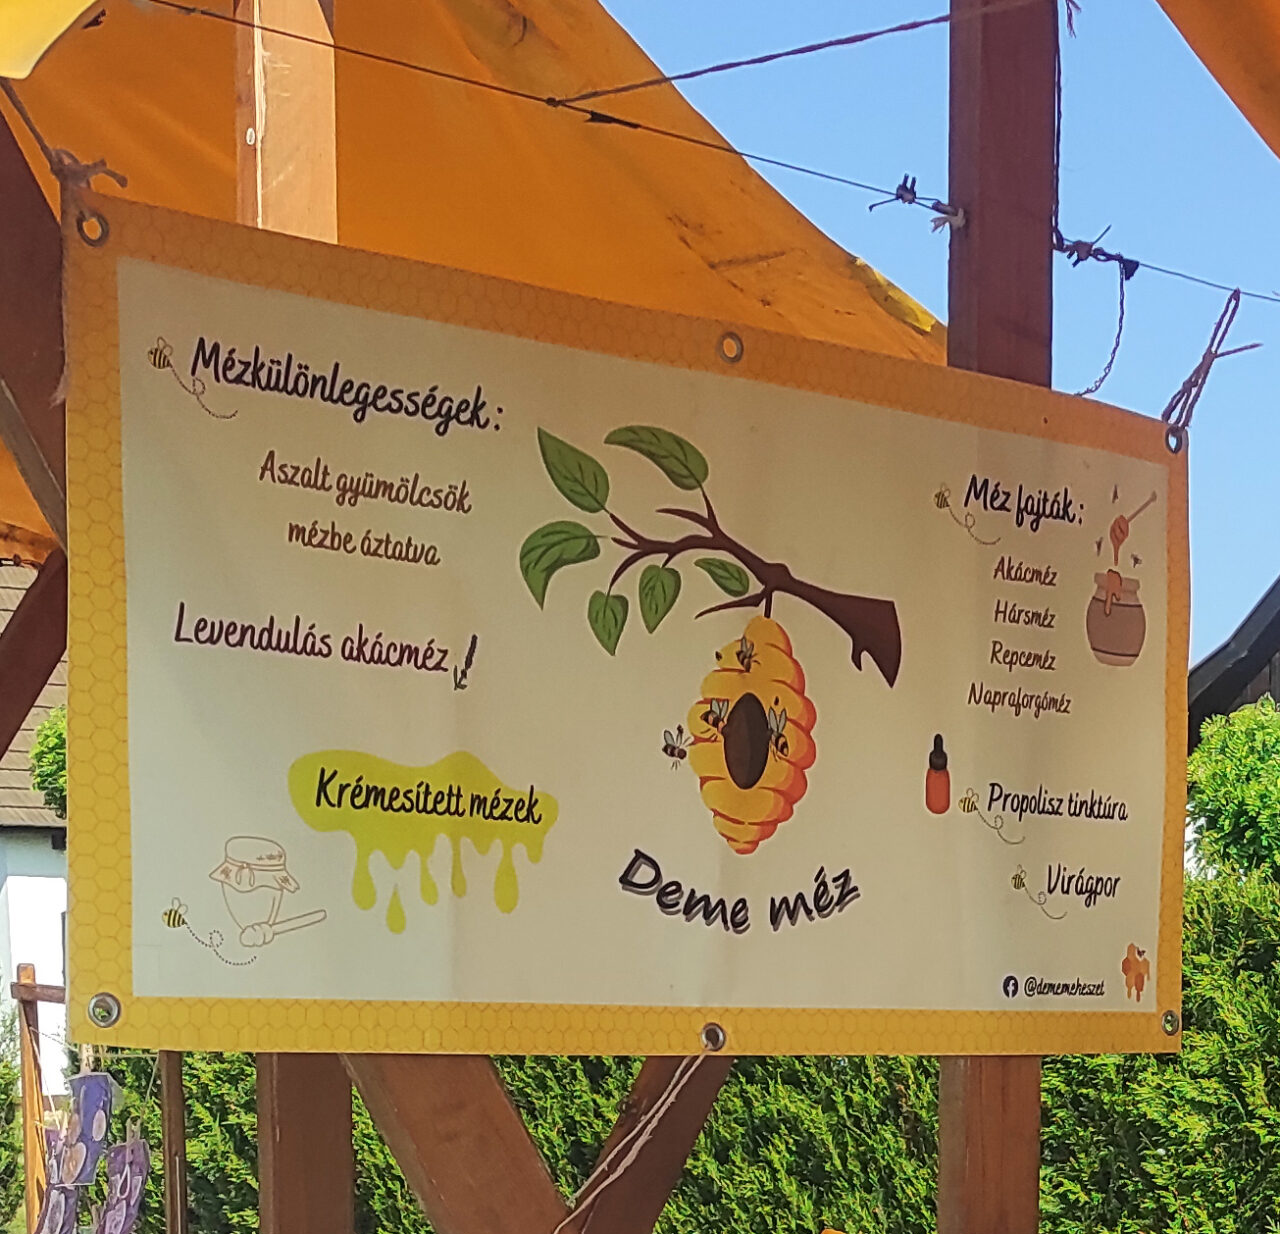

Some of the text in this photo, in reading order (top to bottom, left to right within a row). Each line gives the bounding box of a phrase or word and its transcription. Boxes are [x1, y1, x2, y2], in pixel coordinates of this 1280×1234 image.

[191, 337, 503, 437] Mézkülönlegességek:
[260, 450, 473, 514] Aszalt gyümölcsök
[964, 474, 1084, 532] Méz fajták:
[288, 520, 441, 566] mézbe áztatva
[993, 556, 1057, 587] Akácméz
[994, 600, 1056, 629] Hársméz
[174, 602, 449, 674] Levendulás akácméz
[990, 640, 1056, 673] Repceméz
[967, 682, 1071, 719] Napraforgóméz
[314, 767, 543, 825] Krémesített mézek
[987, 782, 1128, 822] Propolisz tinktúra
[618, 848, 860, 934] Deme méz
[1046, 863, 1121, 908] Virágpor
